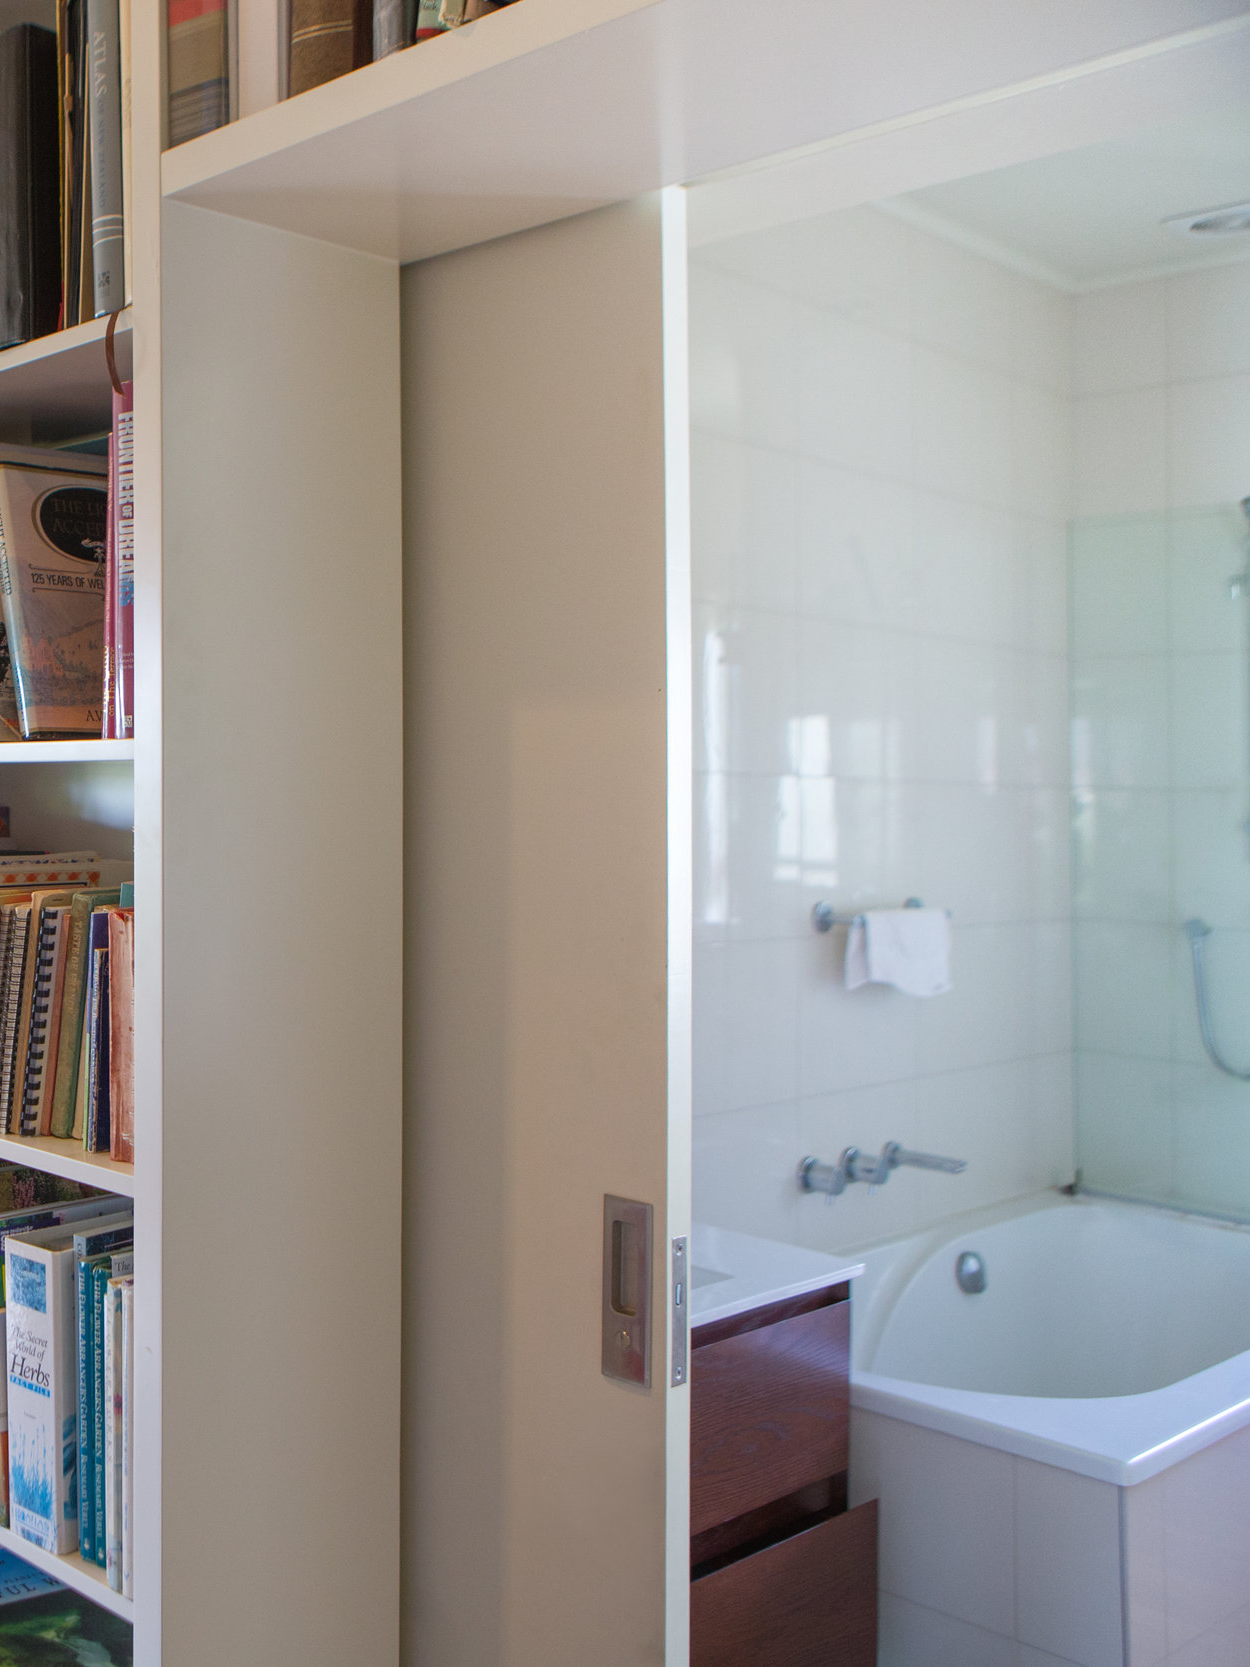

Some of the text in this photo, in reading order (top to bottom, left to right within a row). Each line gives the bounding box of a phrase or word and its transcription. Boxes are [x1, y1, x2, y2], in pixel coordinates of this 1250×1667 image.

[93, 31, 107, 98] ATLAS
[97, 119, 105, 145] NEW
[97, 152, 106, 208] ZEALAND
[118, 412, 134, 606] FRONTIER OF DREAMS
[31, 573, 44, 585] 125
[47, 575, 73, 587] YEARS
[76, 578, 85, 588] OF
[72, 920, 83, 955] TASTE
[78, 1271, 86, 1292] THE
[115, 1262, 130, 1273] The
[94, 1279, 102, 1301] THE
[78, 1293, 87, 1337] FLOWER
[94, 1302, 103, 1346] FLOWER
[12, 1324, 48, 1348] The Secret
[15, 1339, 46, 1361] World of
[10, 1353, 50, 1387] Herbs
[80, 1403, 88, 1450] GARDEN
[95, 1414, 103, 1458] GARDEN
